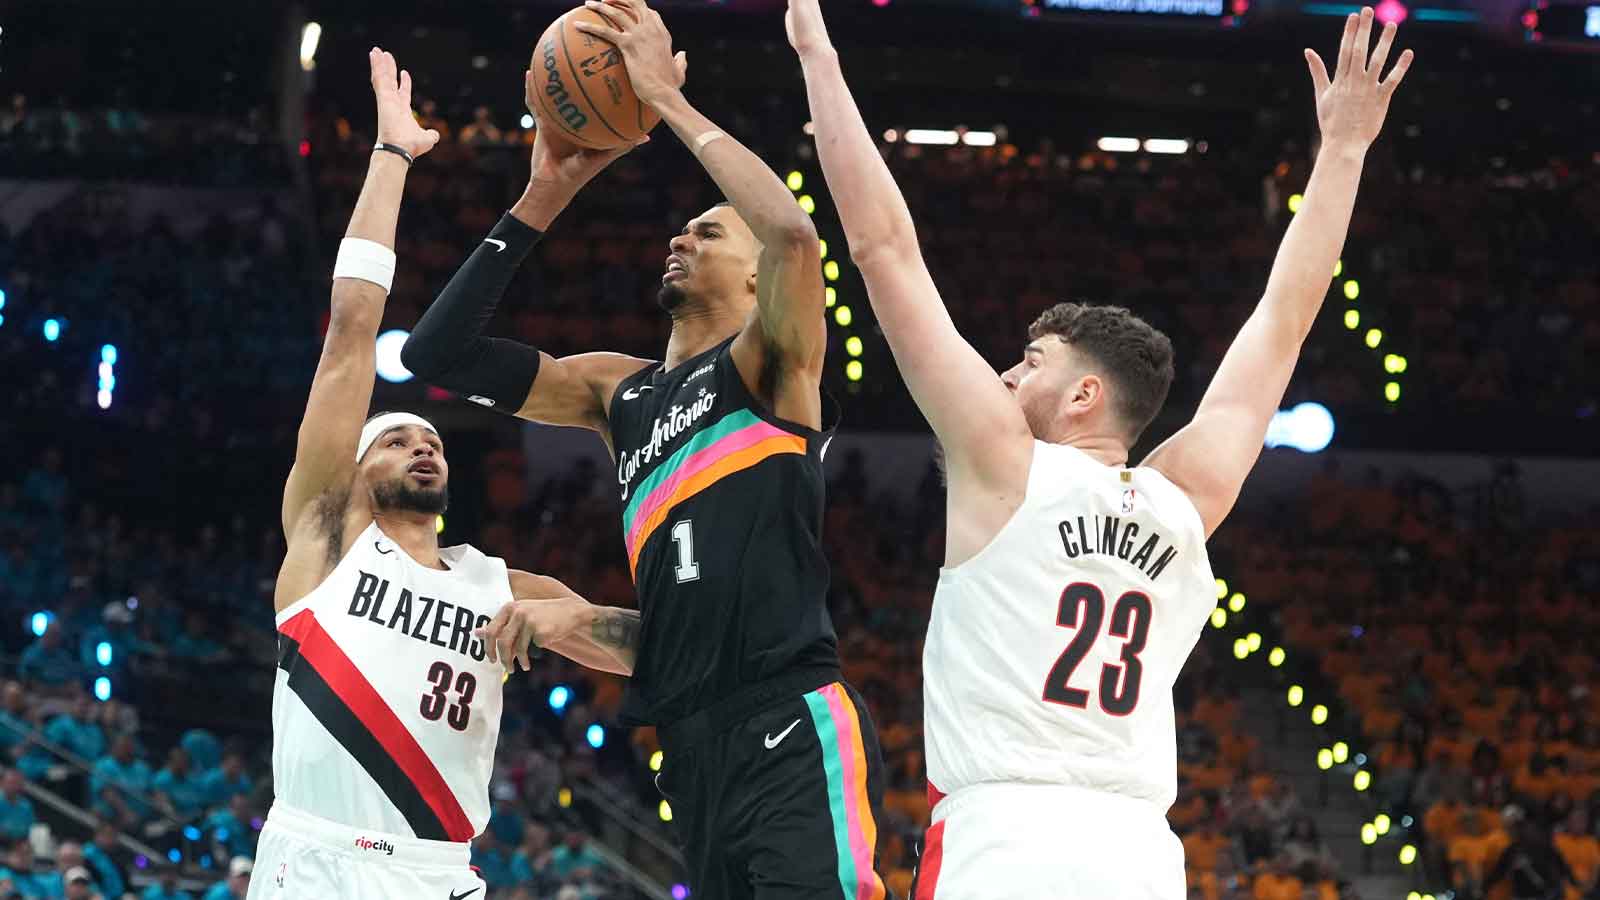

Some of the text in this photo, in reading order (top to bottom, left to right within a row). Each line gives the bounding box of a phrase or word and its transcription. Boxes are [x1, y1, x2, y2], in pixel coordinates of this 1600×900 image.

[543, 39, 588, 132] Wilson
[618, 388, 717, 501] San Antonio
[671, 519, 700, 584] 1
[1058, 515, 1178, 581] CLINGAN
[348, 570, 491, 662] BLAZERS
[1042, 581, 1153, 717] 23
[419, 661, 476, 731] 33
[355, 836, 394, 855] ripcity
